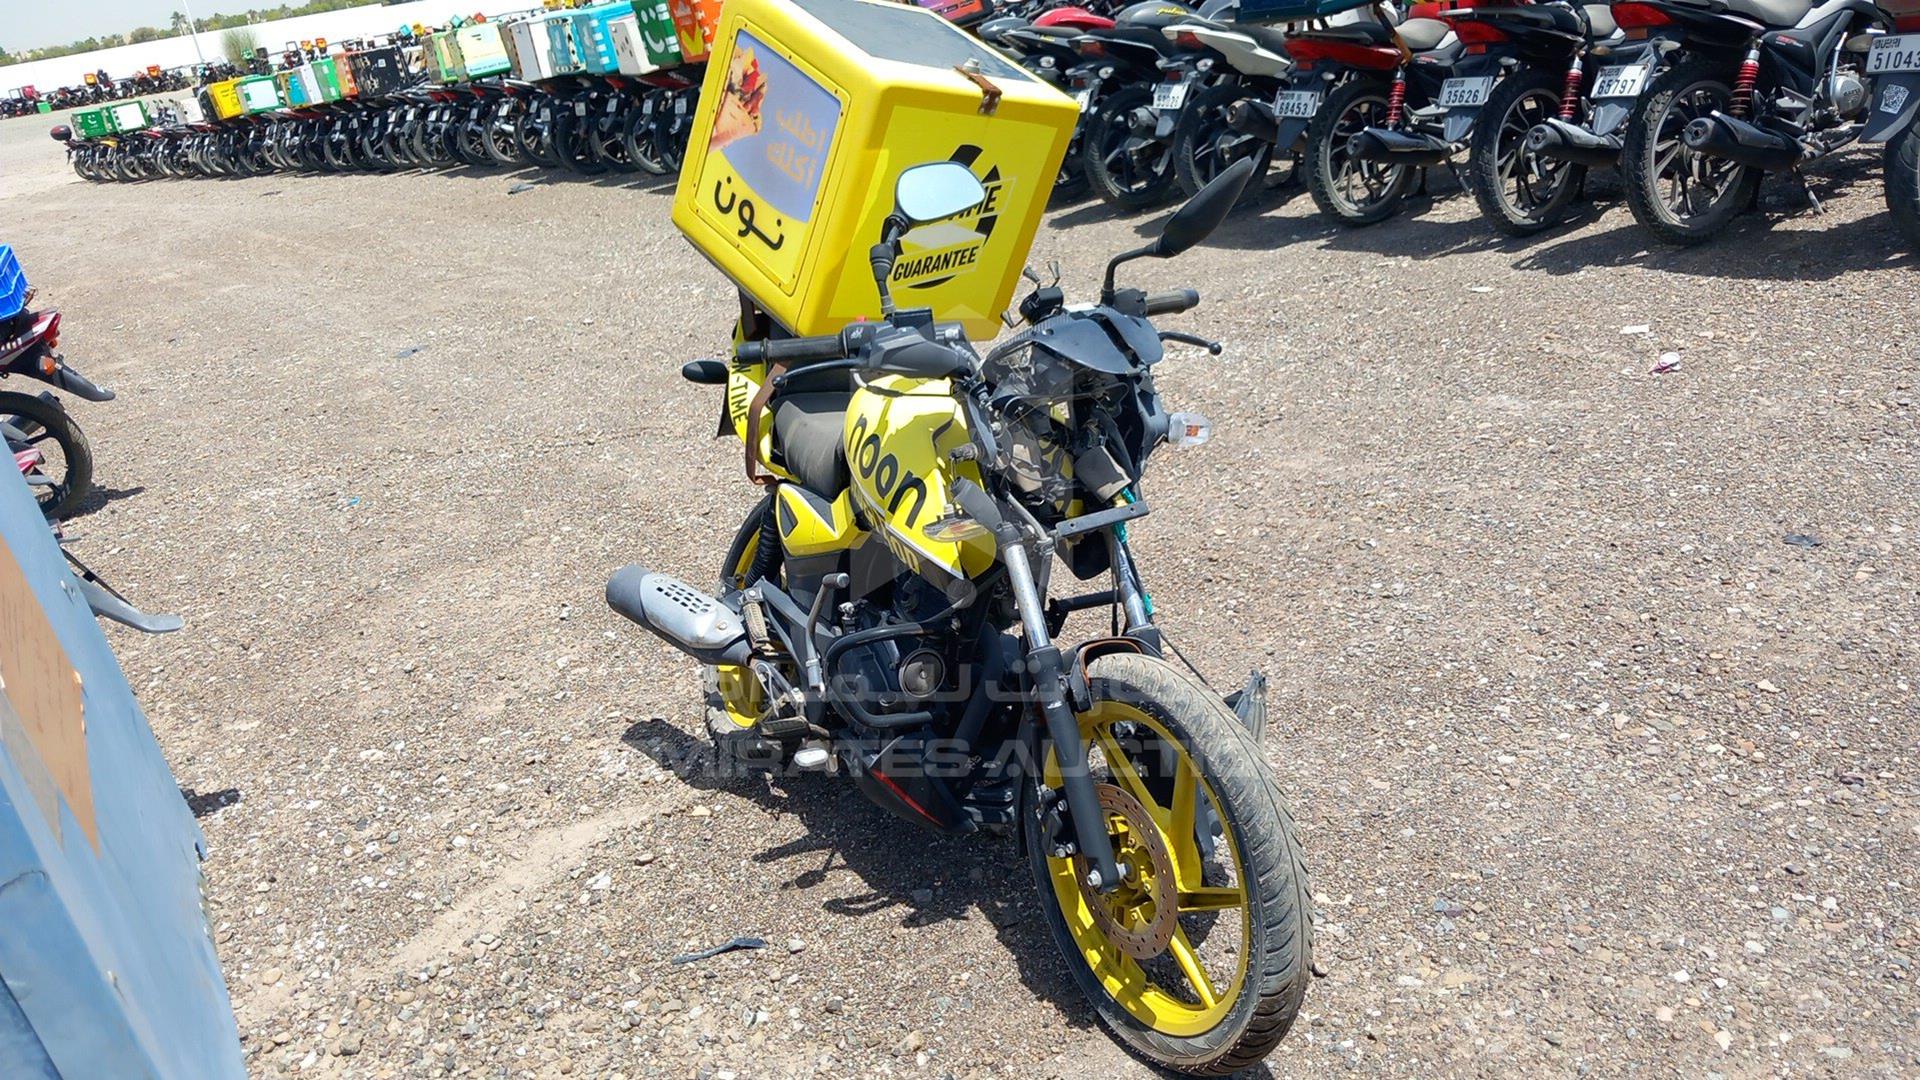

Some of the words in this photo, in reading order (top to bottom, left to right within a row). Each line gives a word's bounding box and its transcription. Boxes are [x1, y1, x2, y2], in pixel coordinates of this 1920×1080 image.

[1873, 50, 1920, 70] 51043
[1445, 88, 1480, 104] 35626
[1597, 79, 1636, 95] 65797
[714, 175, 785, 251] نون
[892, 245, 980, 282] GUARANTEE
[848, 412, 927, 530] noon
